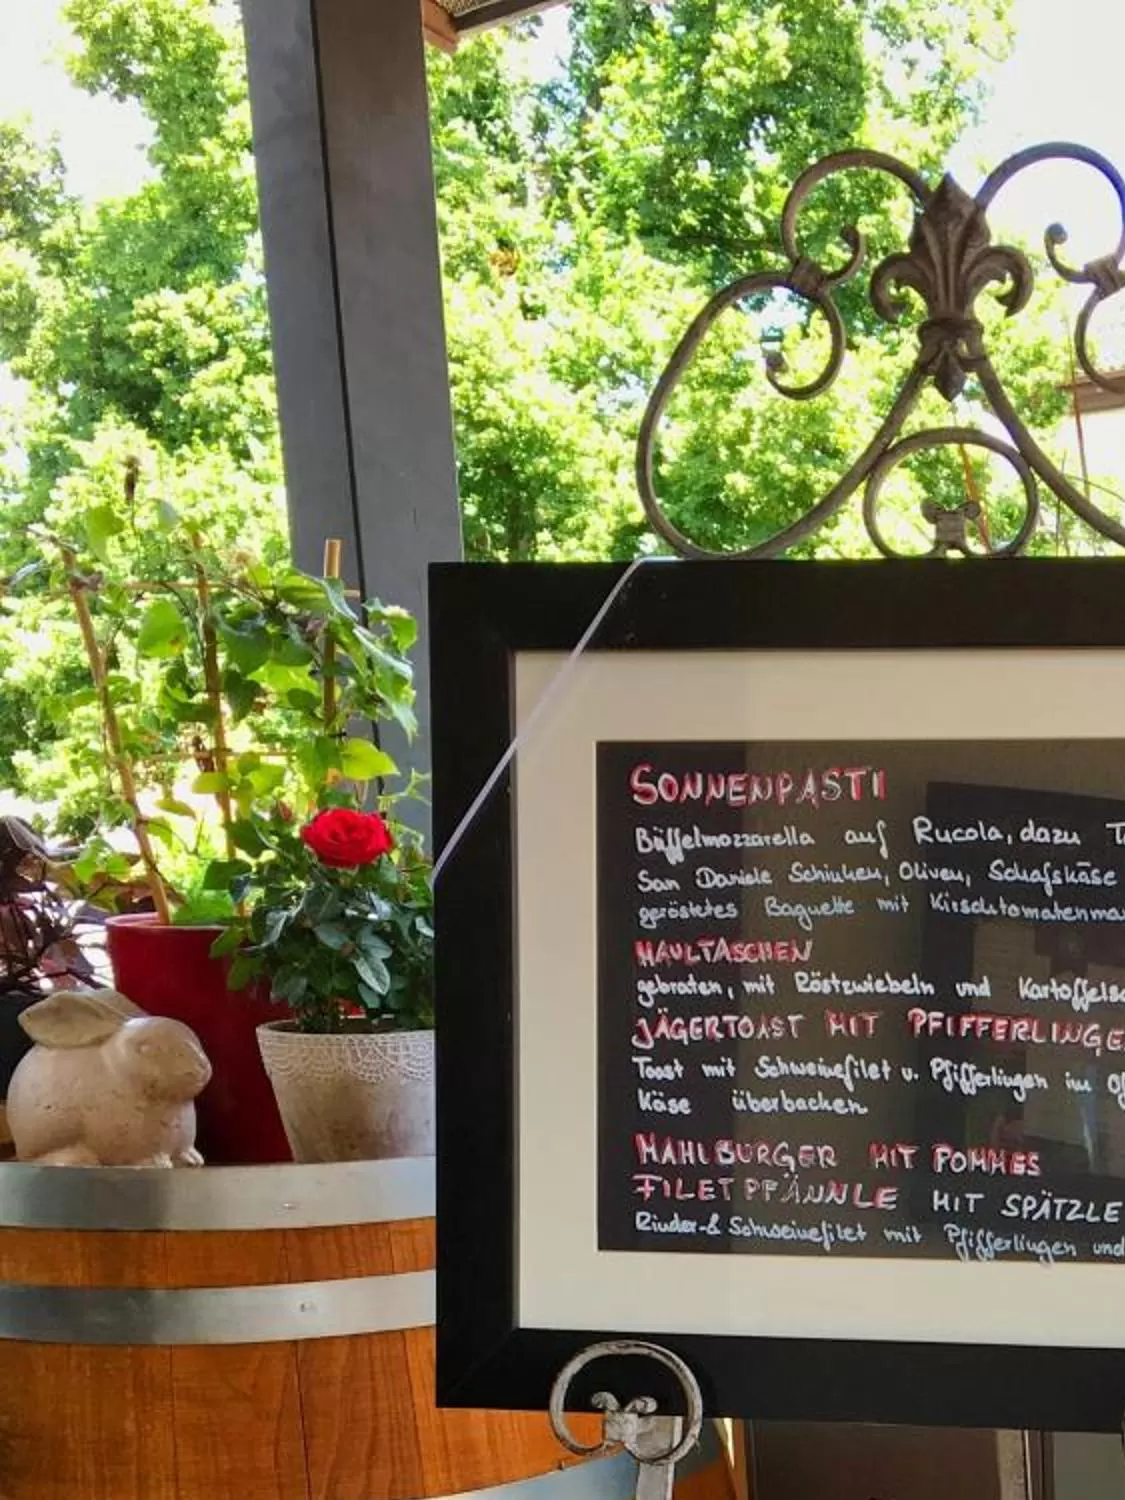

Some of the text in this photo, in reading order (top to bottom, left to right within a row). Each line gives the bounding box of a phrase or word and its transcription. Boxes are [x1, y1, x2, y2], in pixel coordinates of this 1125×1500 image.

[635, 825, 815, 865] Büffelmozzarella
[844, 820, 888, 859] auf
[912, 815, 1014, 845] Rucola,
[1019, 818, 1081, 845] dazu
[637, 869, 681, 893] San
[695, 866, 773, 890] Daniele
[788, 861, 891, 888] Schinken,
[899, 861, 971, 888] Oliven,
[988, 860, 1118, 897] Schafskäse
[638, 899, 738, 929] geröstetes
[763, 896, 855, 931] Baguette
[877, 895, 910, 914] mit
[634, 937, 814, 968] MAULTASCHEN
[743, 974, 775, 995] mit
[795, 970, 935, 995] Röstzwiebeln
[955, 976, 991, 998] und
[631, 1006, 805, 1050] JÄGERTOAST
[824, 1007, 881, 1039] MIT
[631, 1056, 685, 1080] Toast
[702, 1057, 736, 1078] mit
[755, 1054, 892, 1092] Schweinefilet
[930, 1057, 1048, 1103] Pfifferlingen
[637, 1088, 692, 1115] Käse
[868, 1142, 920, 1170] MIT
[931, 1143, 1042, 1177] POMMES
[932, 1189, 985, 1213] MIT
[1001, 1190, 1123, 1225] SPÄTZLE
[729, 1215, 867, 1251] Schweinefilet
[884, 1226, 923, 1244] mit
[1093, 1239, 1125, 1258] und
